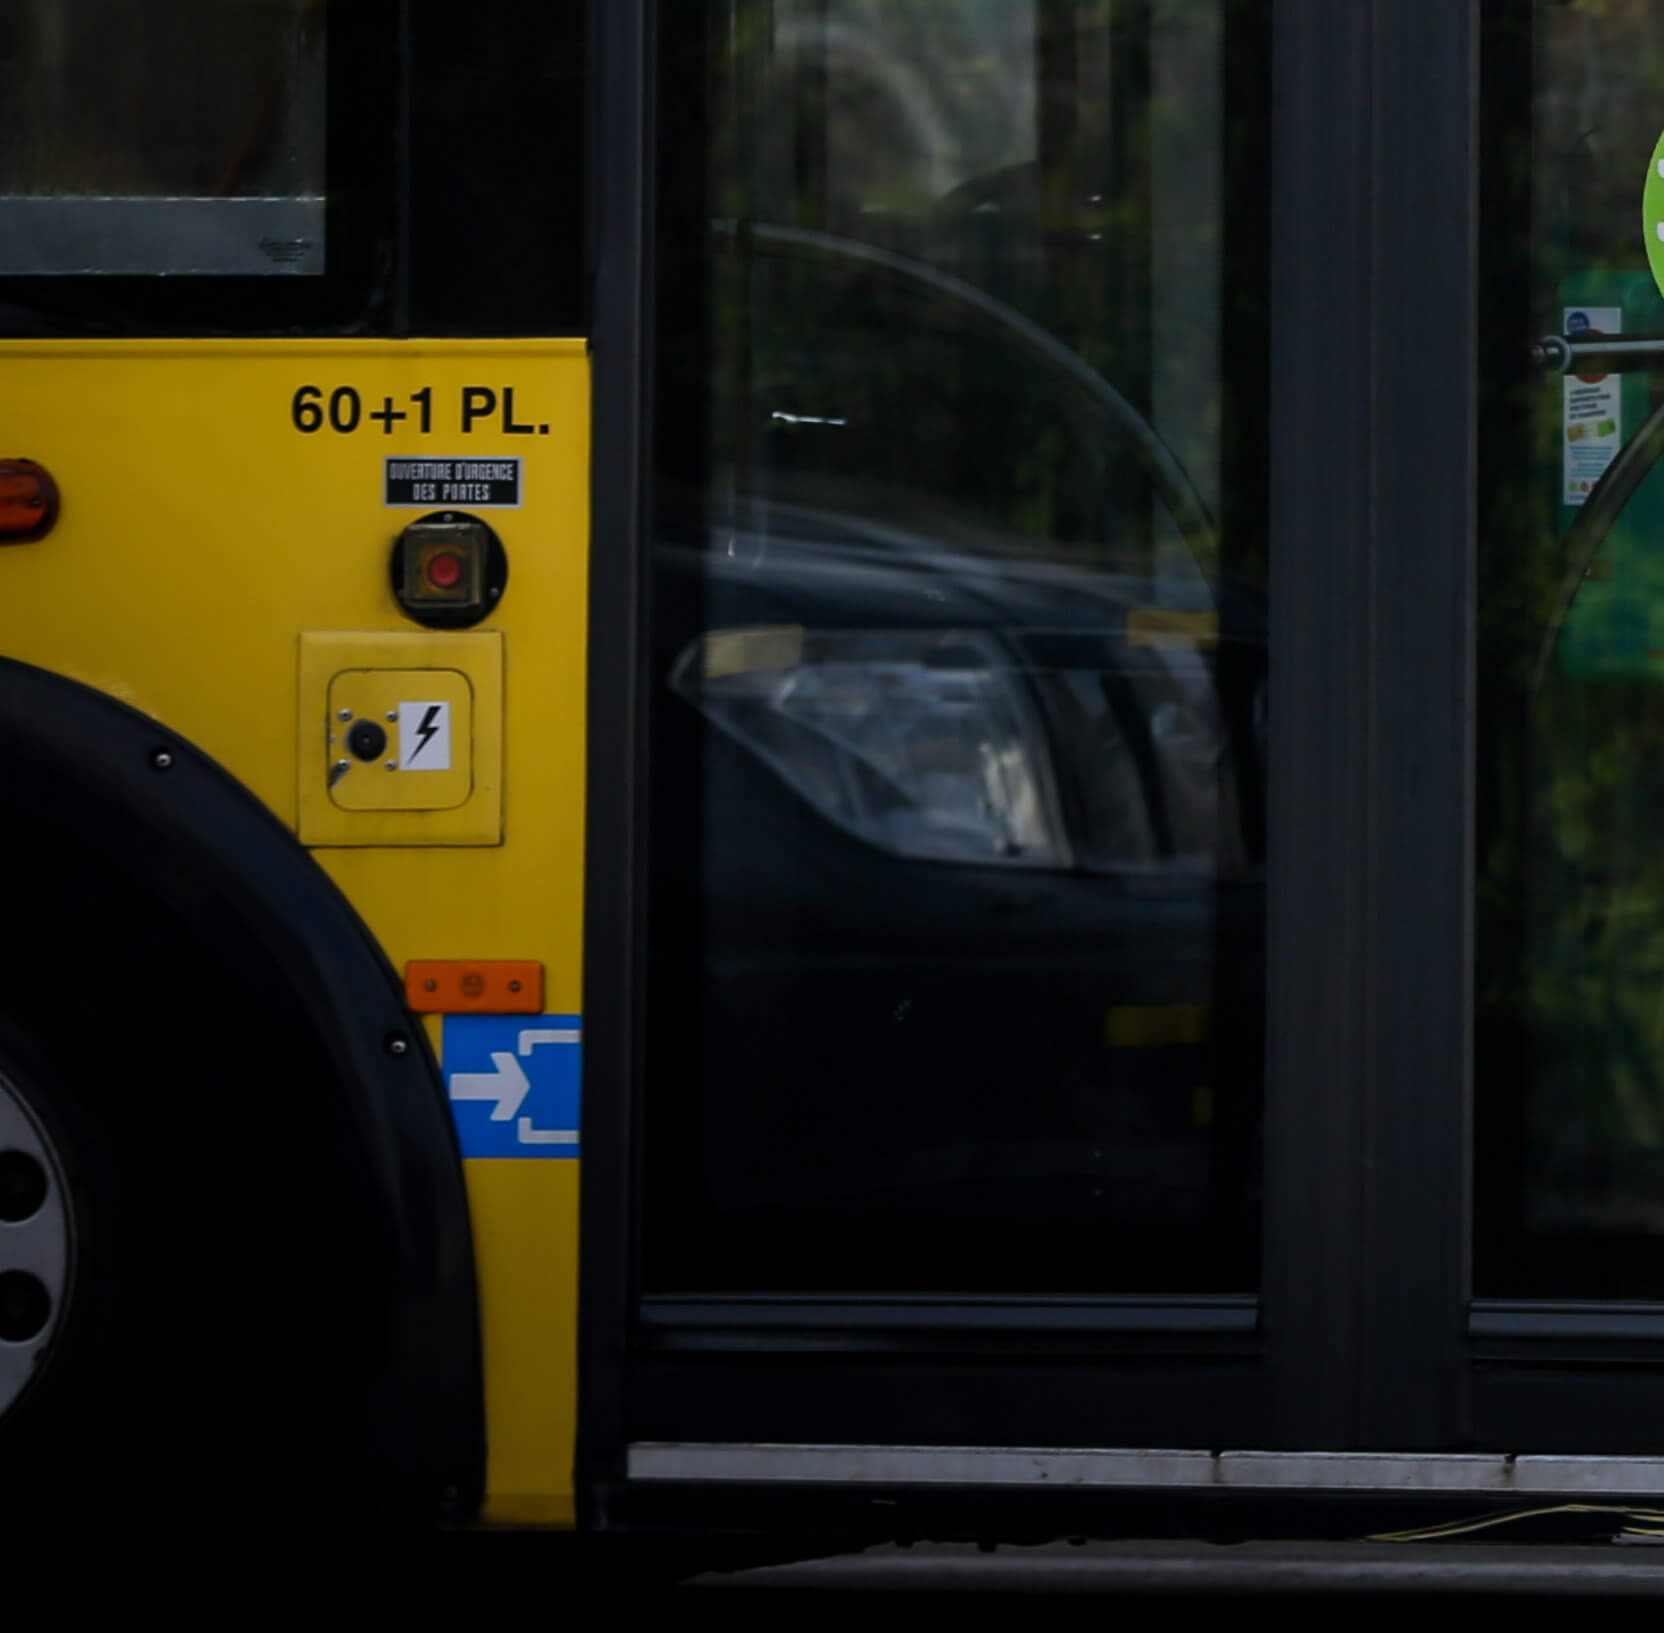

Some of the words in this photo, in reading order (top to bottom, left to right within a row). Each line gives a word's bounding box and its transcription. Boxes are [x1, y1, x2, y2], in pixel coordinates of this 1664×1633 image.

[291, 385, 433, 435] 60+1
[460, 386, 550, 436] PL.
[389, 463, 452, 480] OUVERTURE
[455, 462, 514, 480] D'URGENCE
[413, 483, 436, 501] DES
[442, 483, 490, 501] PORTES
